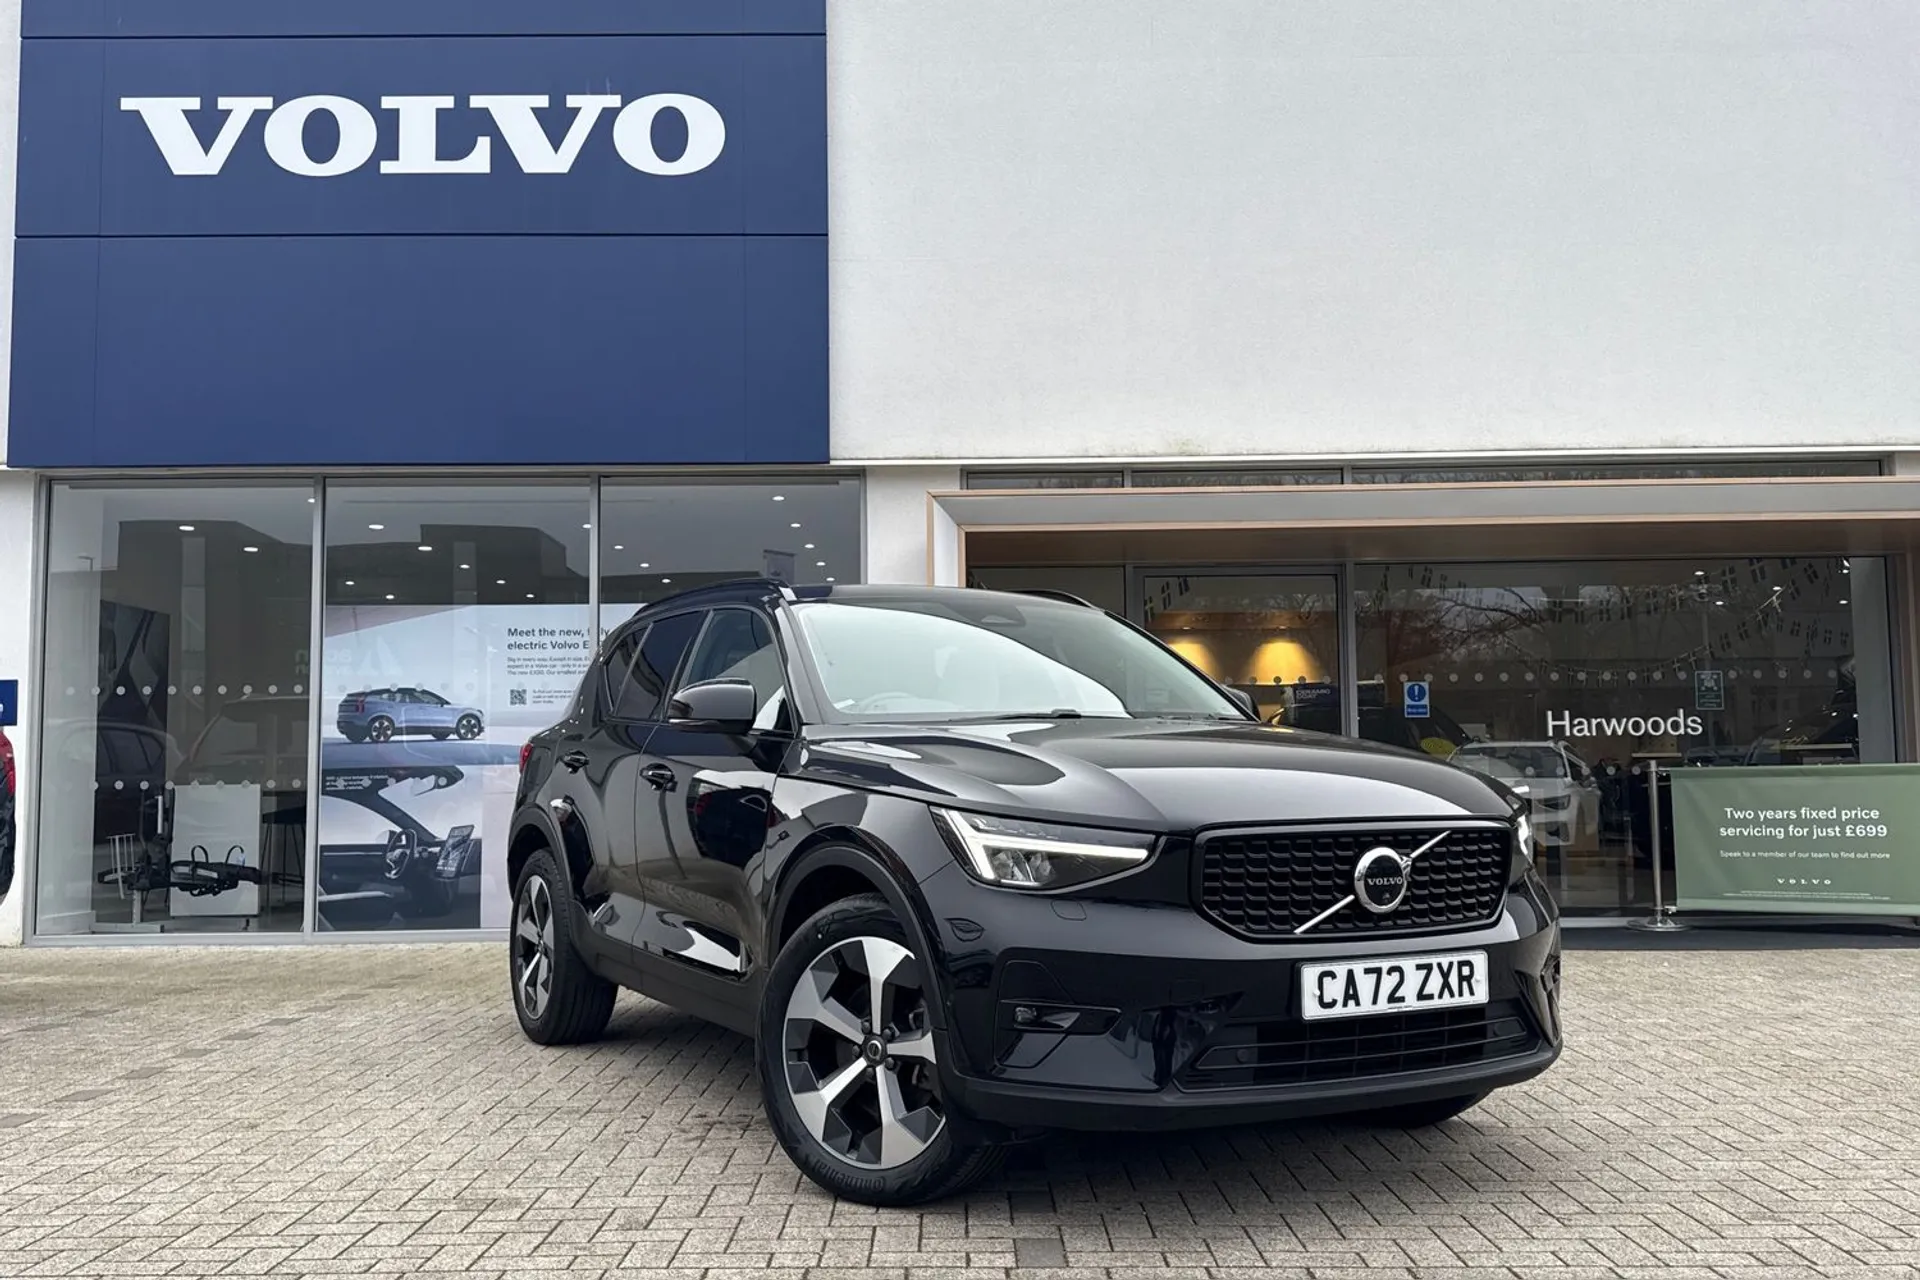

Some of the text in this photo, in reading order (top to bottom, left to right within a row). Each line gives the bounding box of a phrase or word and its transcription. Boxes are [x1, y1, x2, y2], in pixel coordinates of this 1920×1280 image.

[119, 93, 726, 177] VOLVO
[507, 628, 535, 637] Meet
[538, 628, 556, 637] the
[558, 629, 584, 638] new,
[507, 640, 548, 650] electric
[550, 641, 580, 650] Volvo
[1546, 708, 1703, 737] Harwoods
[1724, 806, 1880, 822] Two years fixed price
[1720, 824, 1888, 840] servicing for just £699
[1719, 849, 1742, 859] Speak
[1742, 850, 1750, 858] to
[1757, 850, 1786, 858] member
[1788, 850, 1797, 858] of
[1811, 851, 1830, 859] team
[1830, 851, 1839, 859] to
[1840, 851, 1855, 859] find
[1856, 851, 1869, 859] out
[1367, 876, 1403, 886] VOLVO
[1776, 877, 1832, 885] VOLVO
[1317, 959, 1475, 1009] CA72 ZXR
